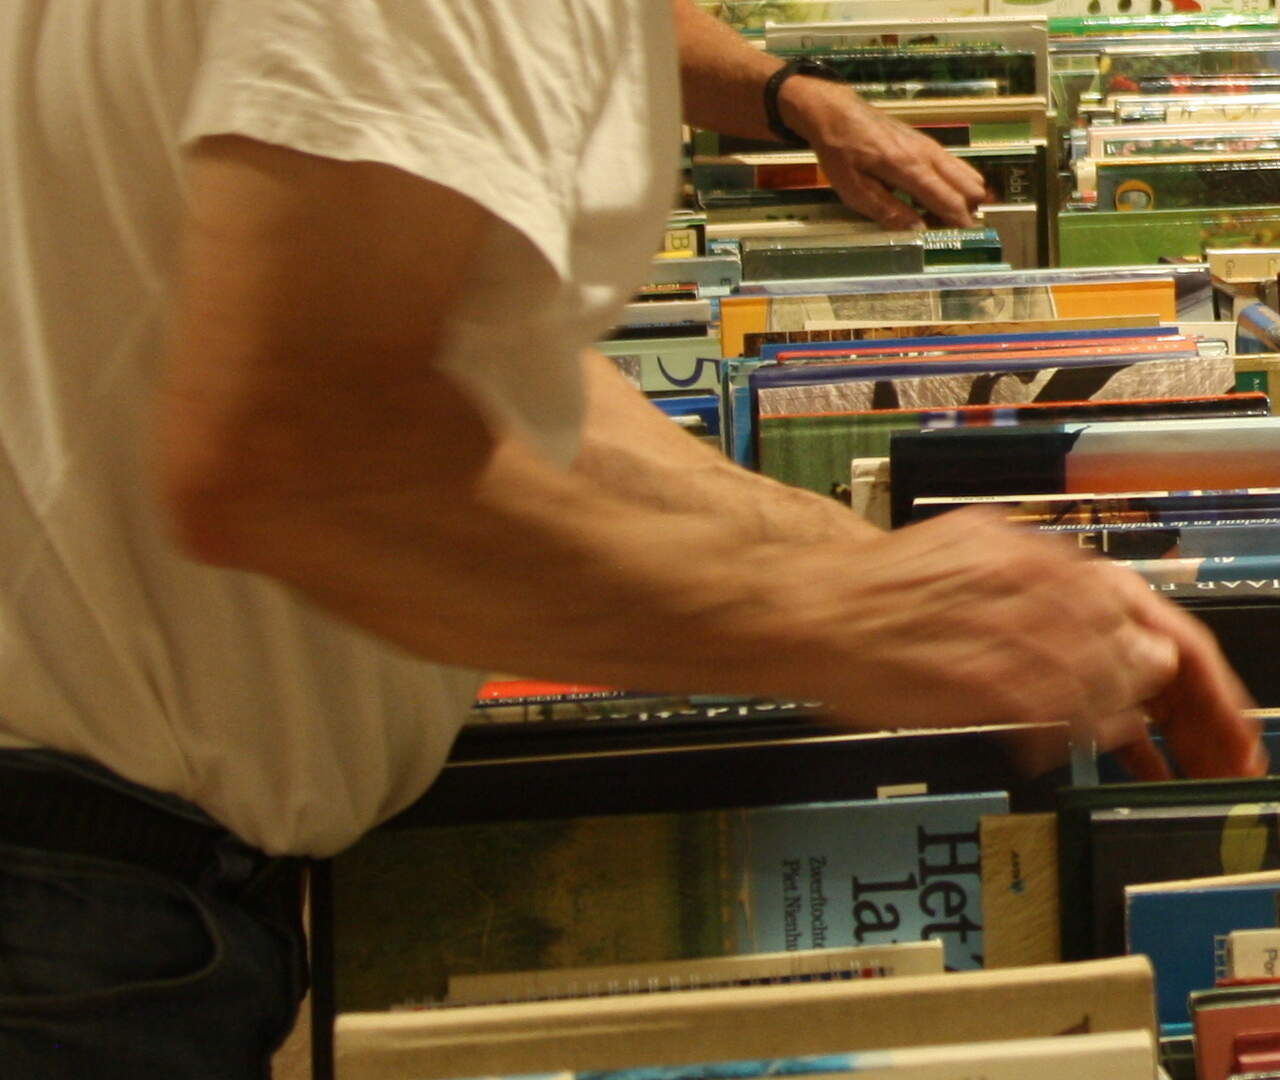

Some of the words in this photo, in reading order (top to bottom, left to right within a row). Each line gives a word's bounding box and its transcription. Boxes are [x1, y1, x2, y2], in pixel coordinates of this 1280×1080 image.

[671, 232, 690, 250] B
[782, 859, 802, 893] Piet
[917, 821, 985, 945] Het
[851, 871, 918, 946] la
